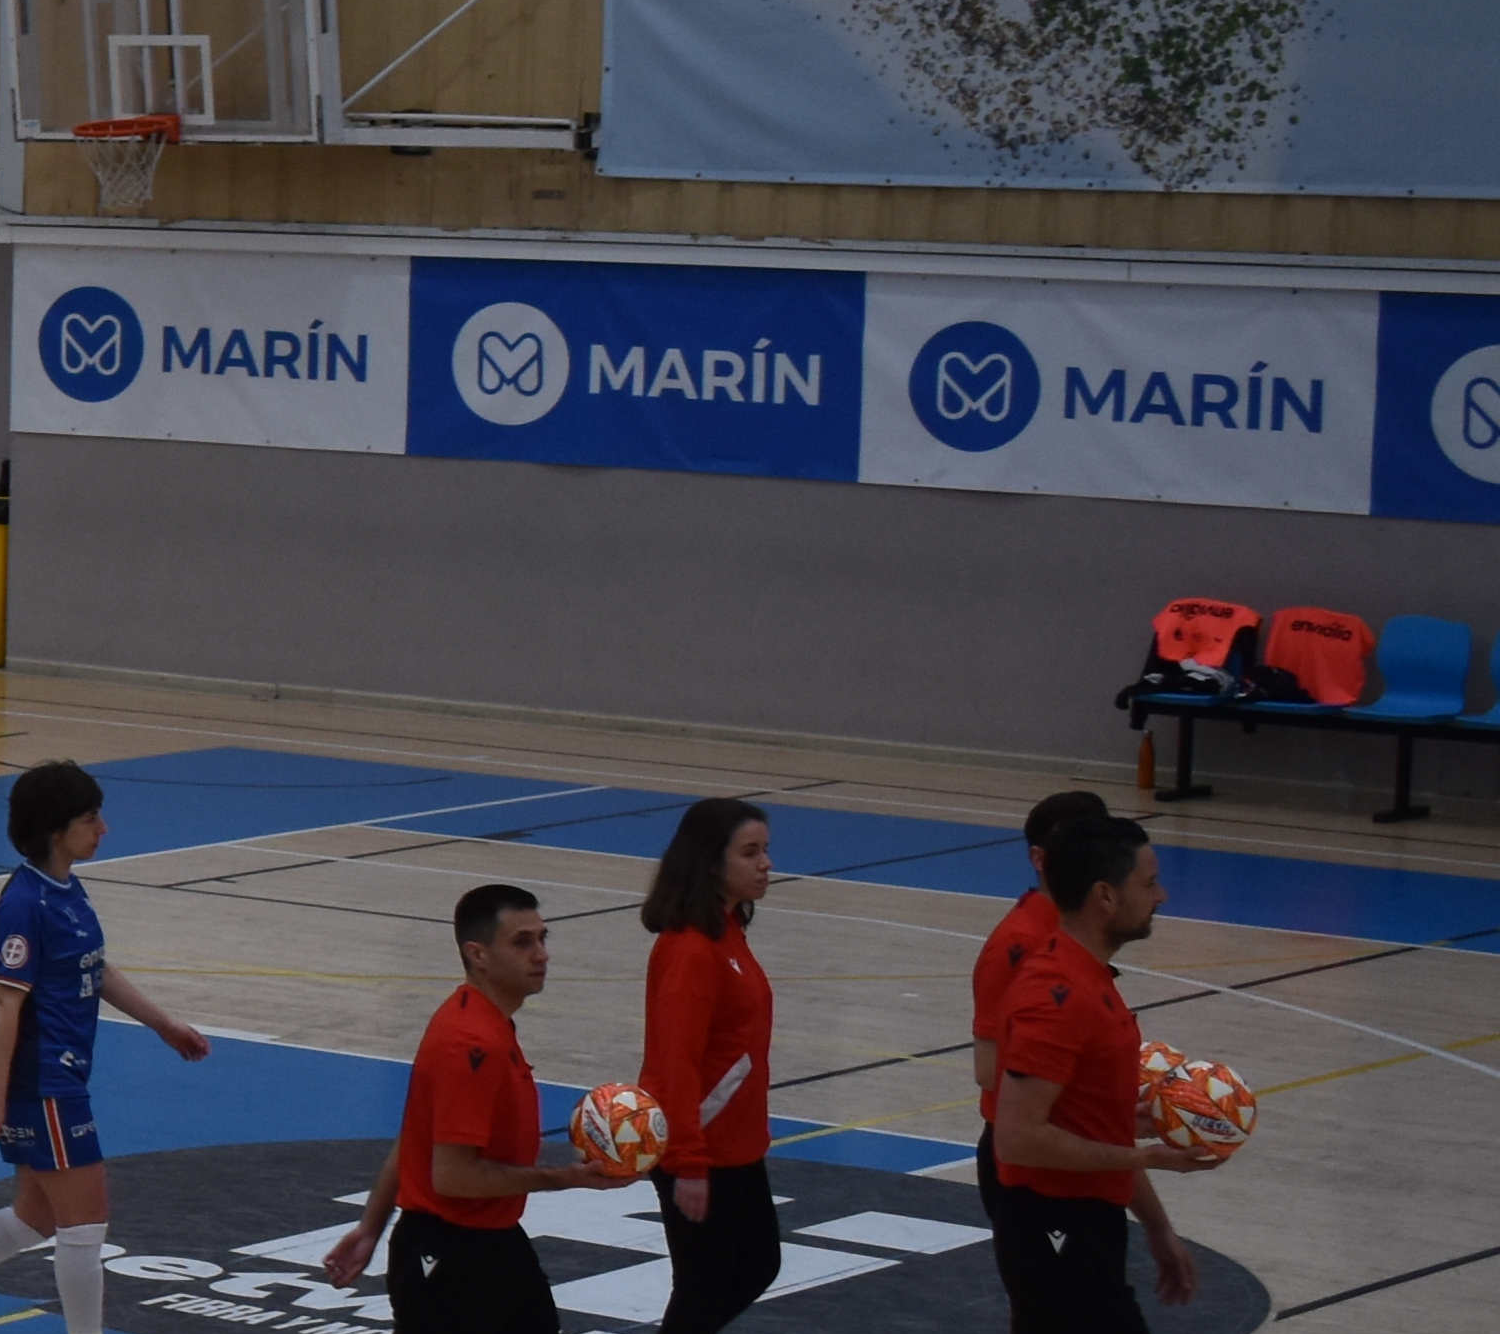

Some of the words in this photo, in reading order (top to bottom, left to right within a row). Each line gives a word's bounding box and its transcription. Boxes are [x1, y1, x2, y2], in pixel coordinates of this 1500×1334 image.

[161, 320, 368, 383] MARÍN
[588, 338, 822, 407] MARÍN
[1062, 361, 1324, 434] MARÍN
[140, 1293, 286, 1326] FIBRA
[271, 1315, 324, 1331] Y
